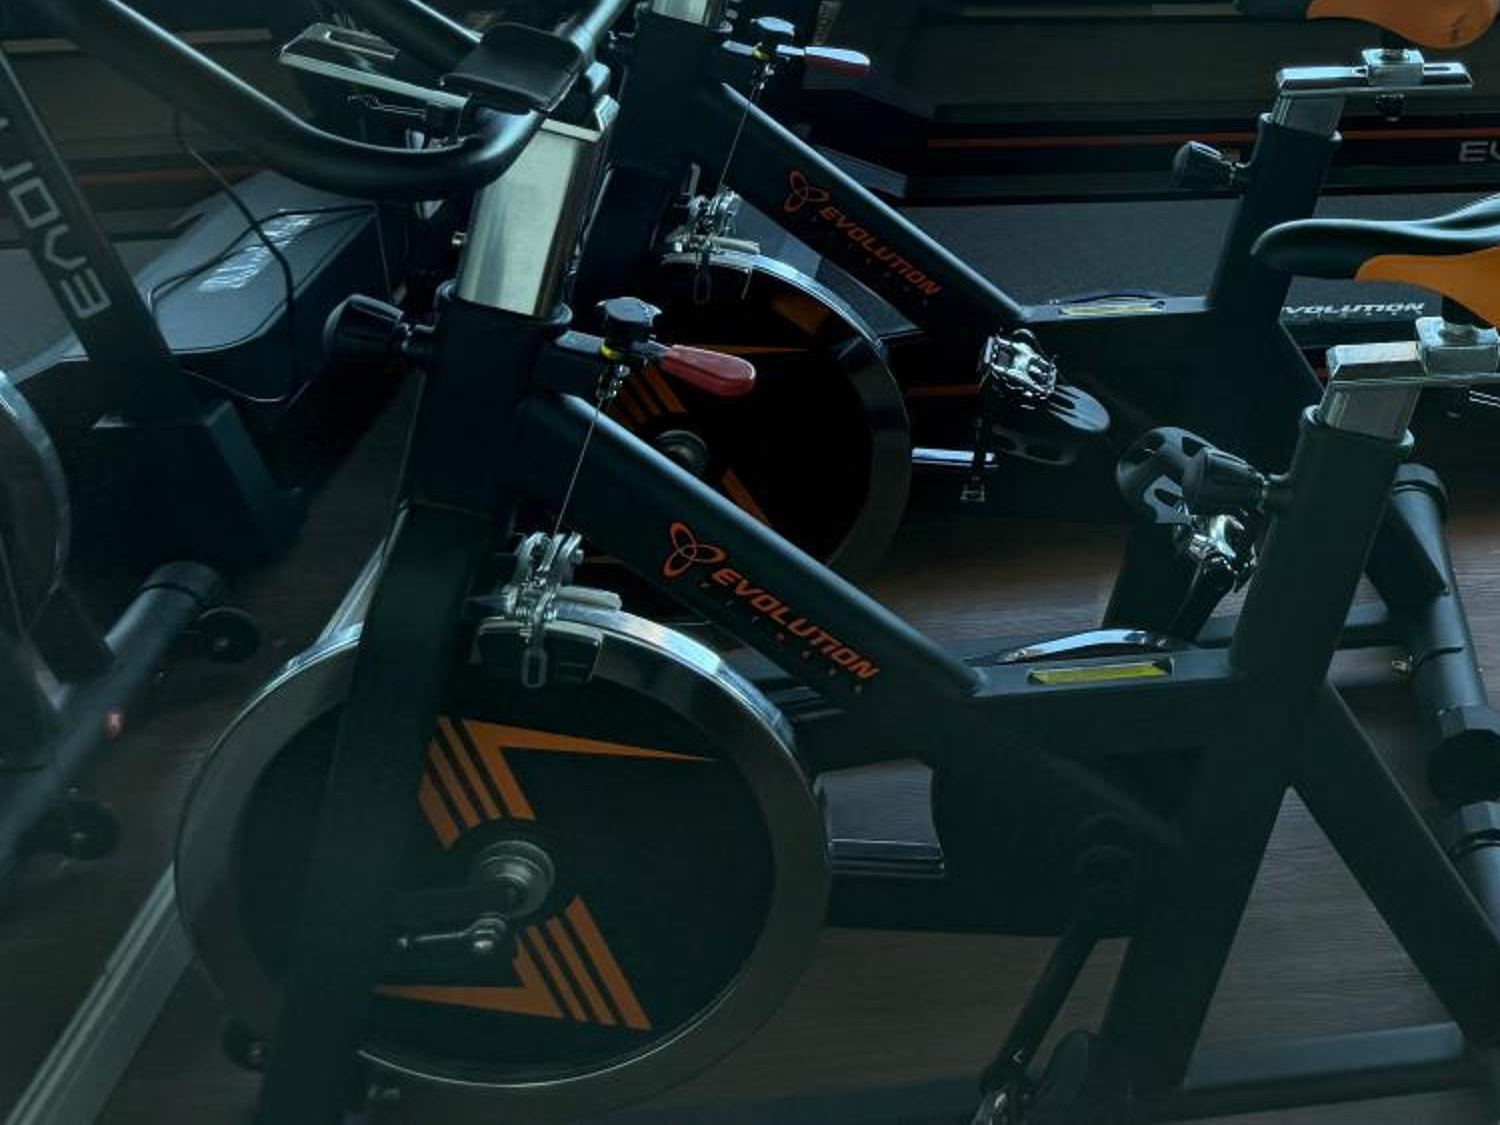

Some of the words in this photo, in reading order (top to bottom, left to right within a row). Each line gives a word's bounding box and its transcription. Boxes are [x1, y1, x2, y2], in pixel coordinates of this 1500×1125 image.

[819, 204, 944, 299] EVOLUTION
[1282, 301, 1426, 316] VOLUTION
[711, 567, 881, 680] EVOLUTION
